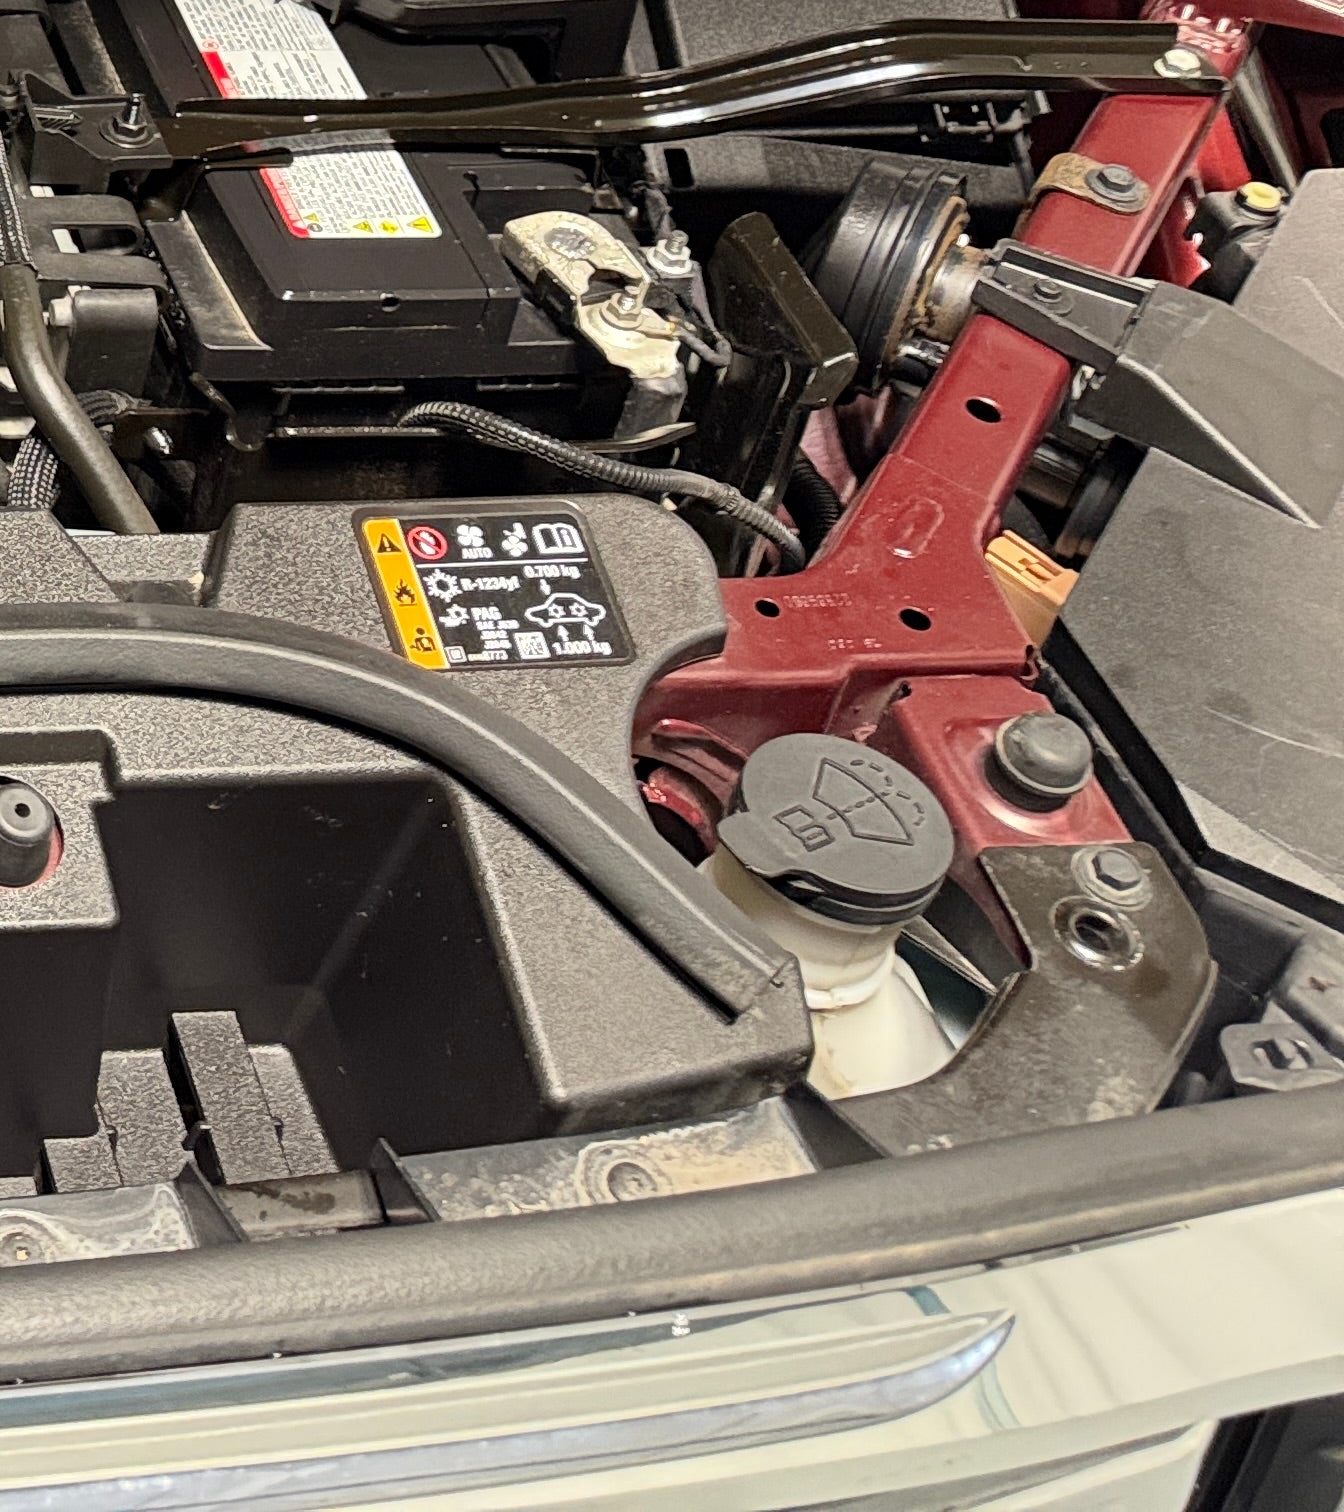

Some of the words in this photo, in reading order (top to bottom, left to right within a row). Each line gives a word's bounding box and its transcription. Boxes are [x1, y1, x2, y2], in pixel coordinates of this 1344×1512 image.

[462, 547, 493, 559] AUTO
[560, 564, 582, 579] kg
[460, 576, 521, 591] R-1234yf
[469, 606, 503, 620] PAG
[551, 640, 592, 657] 1.000
[591, 639, 613, 656] kg
